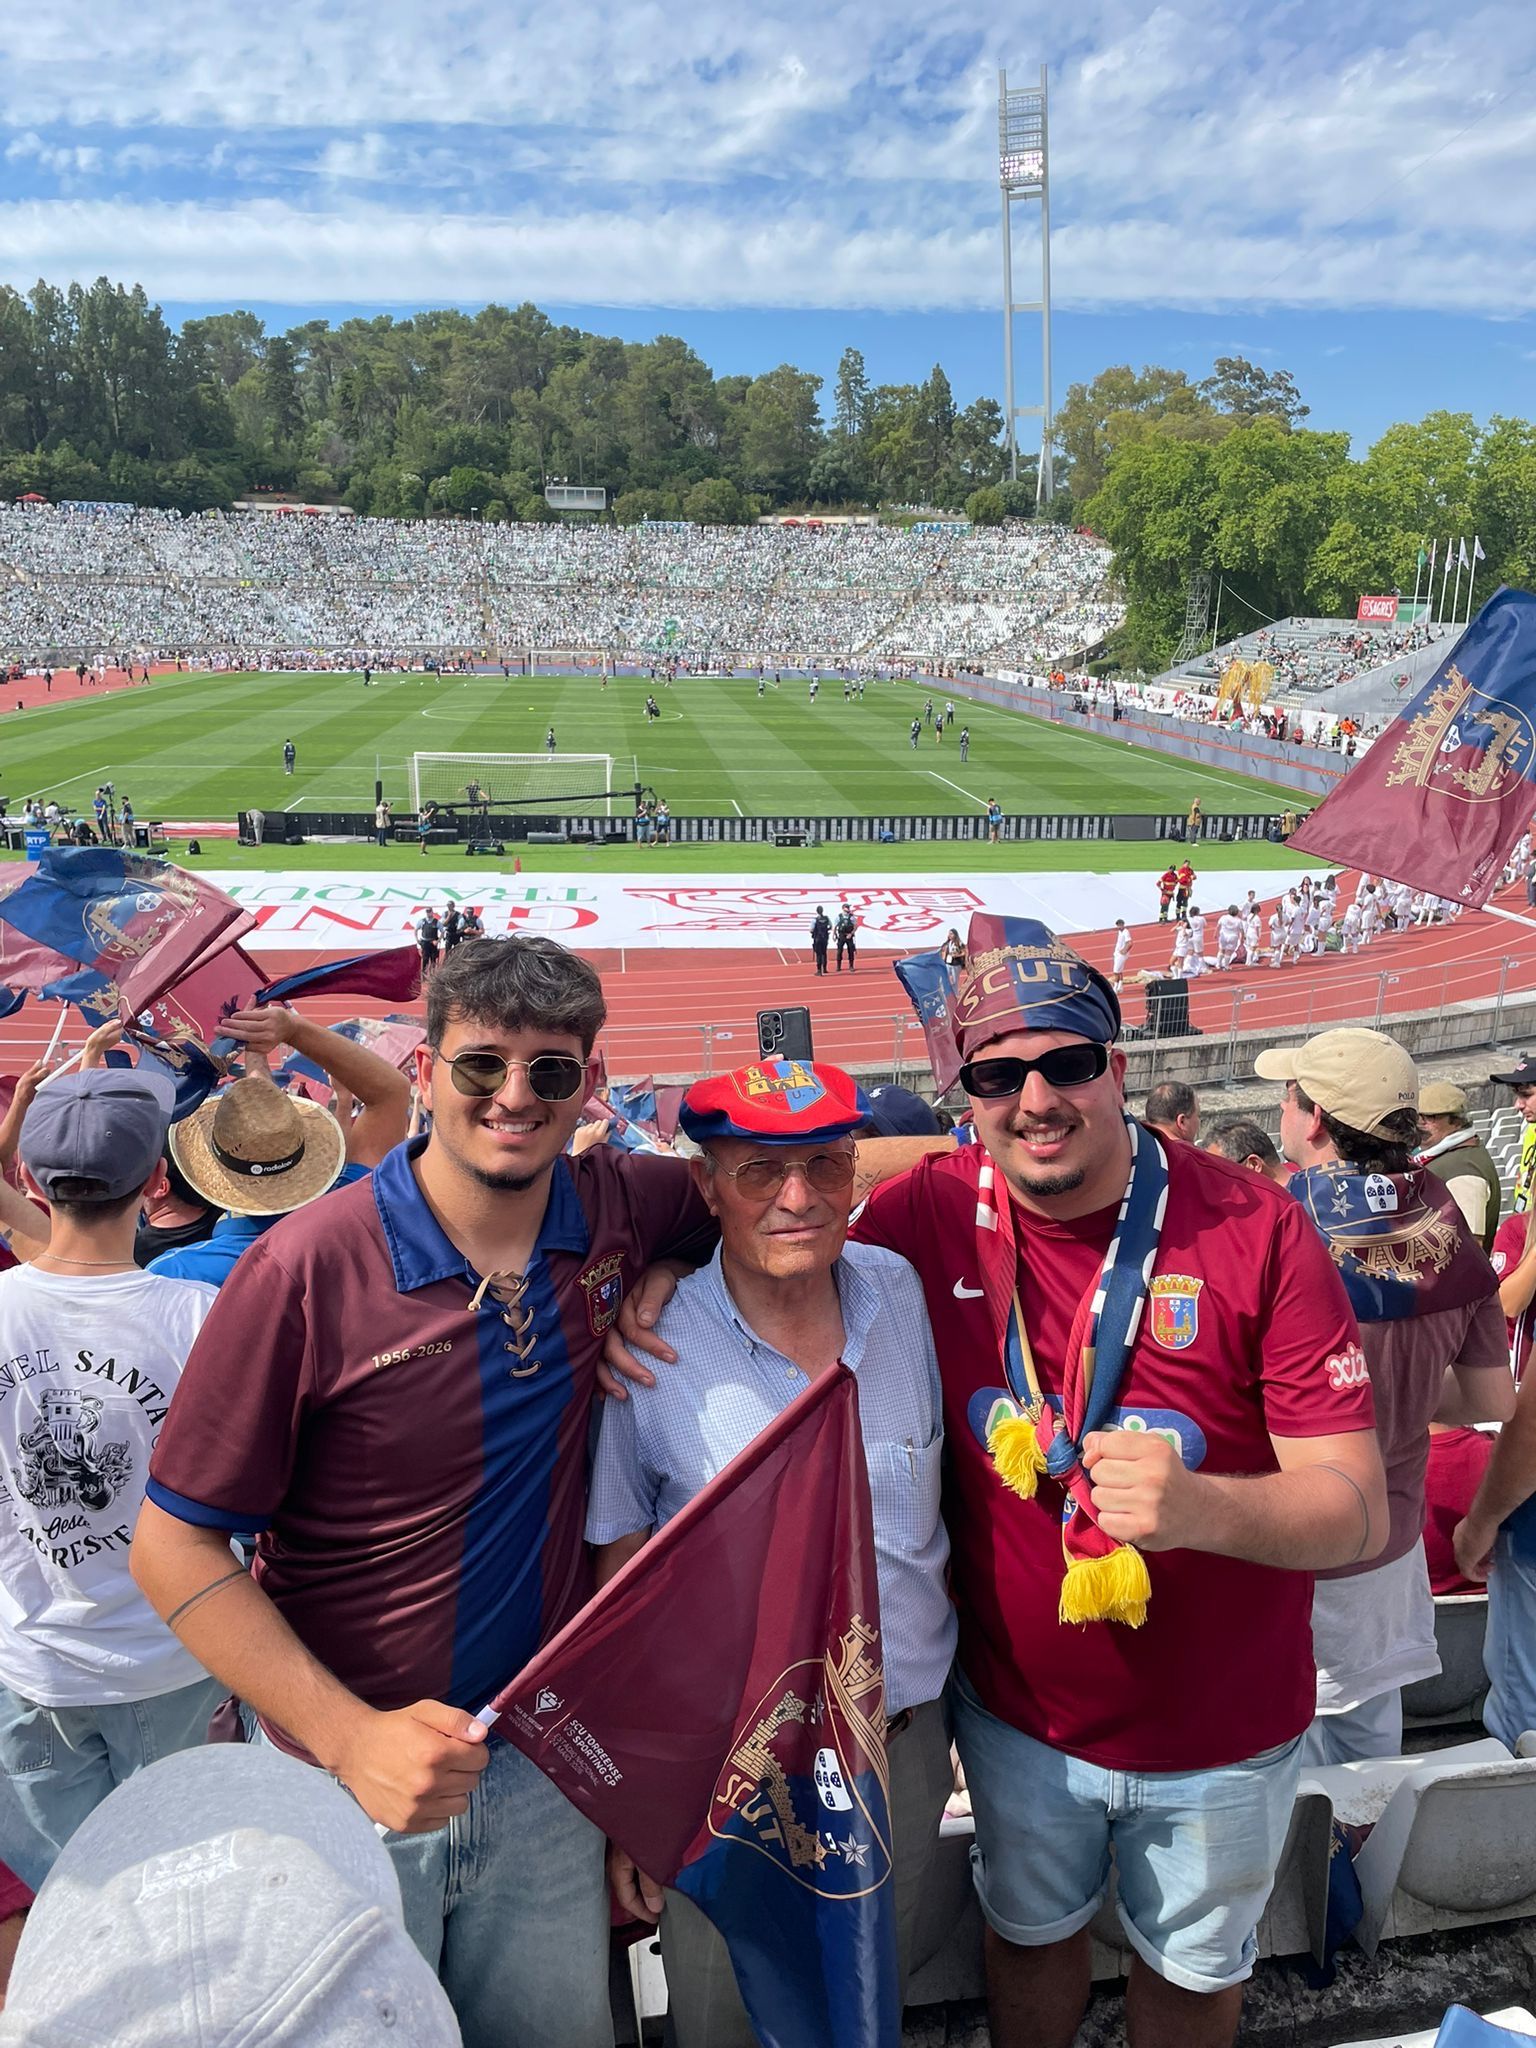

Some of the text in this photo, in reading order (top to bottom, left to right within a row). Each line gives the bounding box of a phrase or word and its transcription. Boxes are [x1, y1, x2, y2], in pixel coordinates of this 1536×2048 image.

[1368, 600, 1394, 618] SAGRES
[1398, 1092, 1415, 1100] POLO
[371, 1340, 453, 1368] 1956-2026
[0, 1349, 170, 1427] VEL SANTA
[563, 1724, 617, 1787] VS SPORTING CP
[569, 1719, 623, 1782] SCU TORREENSE
